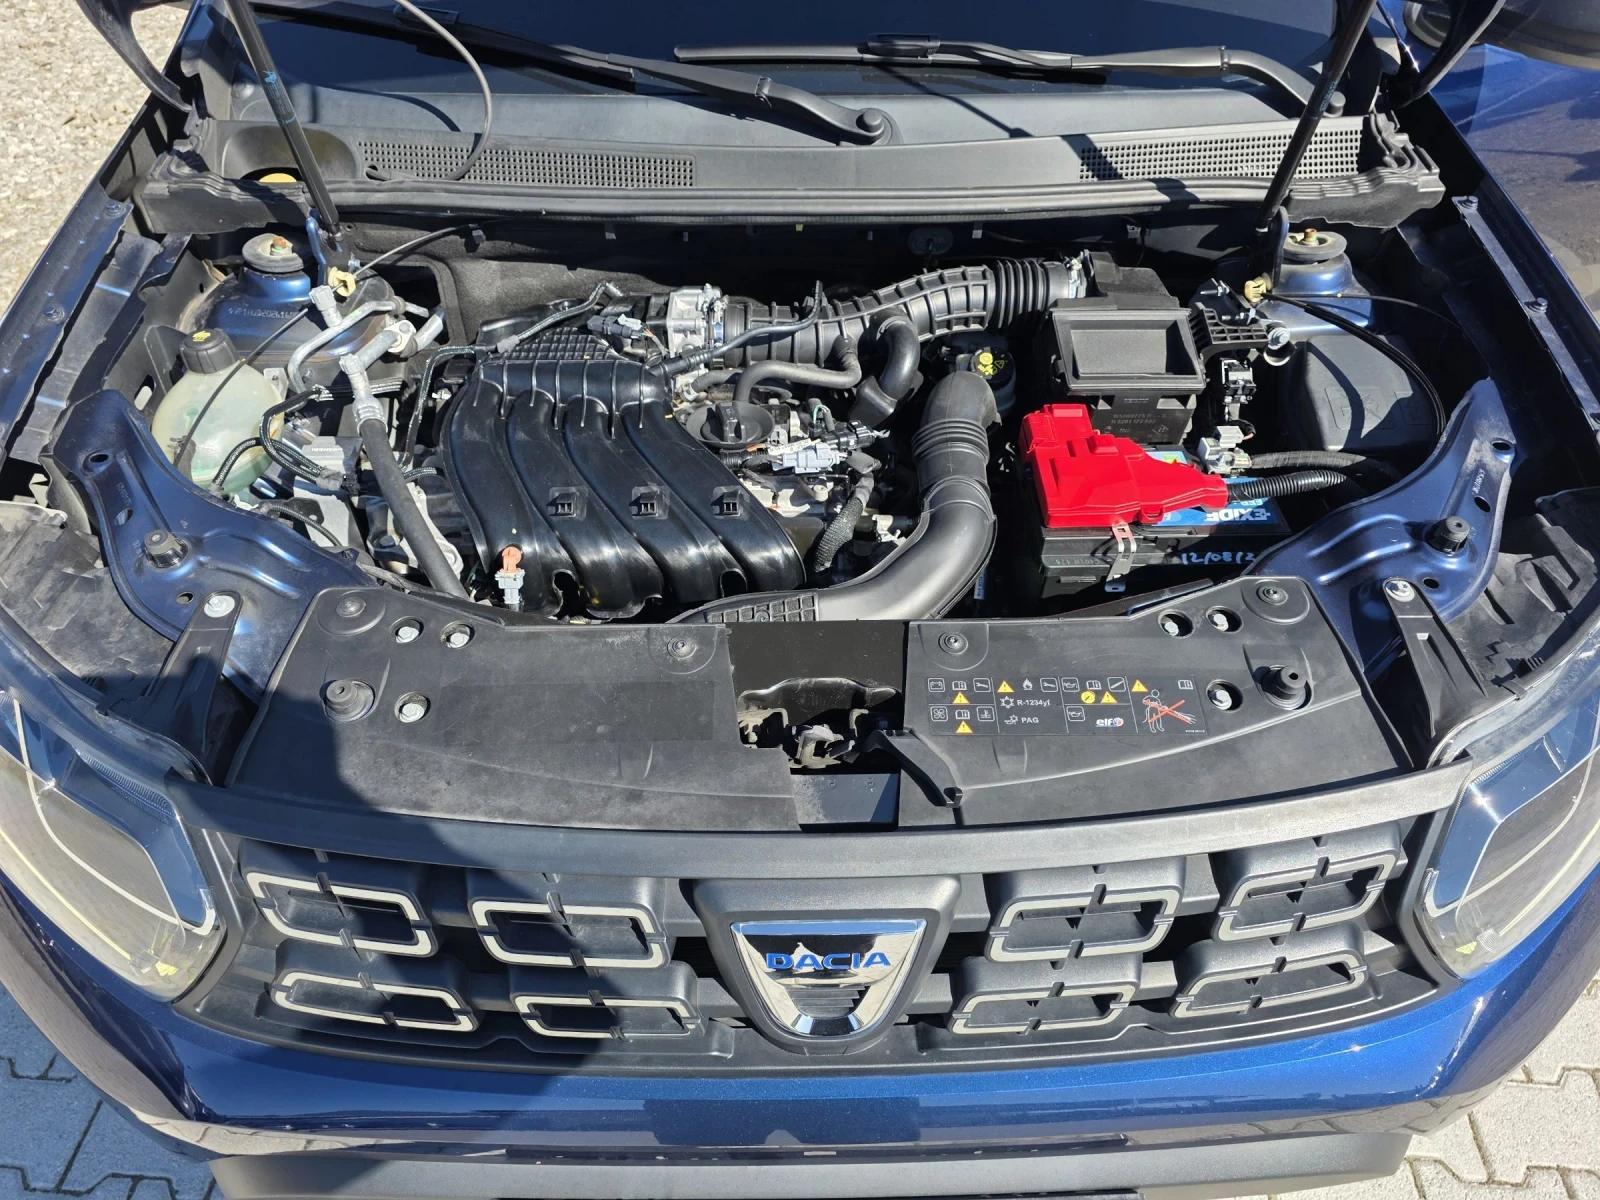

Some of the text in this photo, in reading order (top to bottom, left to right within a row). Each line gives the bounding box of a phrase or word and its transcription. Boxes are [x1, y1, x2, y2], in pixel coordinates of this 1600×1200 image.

[1204, 508, 1271, 521] EXIDE
[1016, 698, 1051, 707] R-1234yf
[1021, 716, 1040, 724] PAG
[1096, 718, 1114, 726] elf
[766, 952, 891, 970] DACIA
